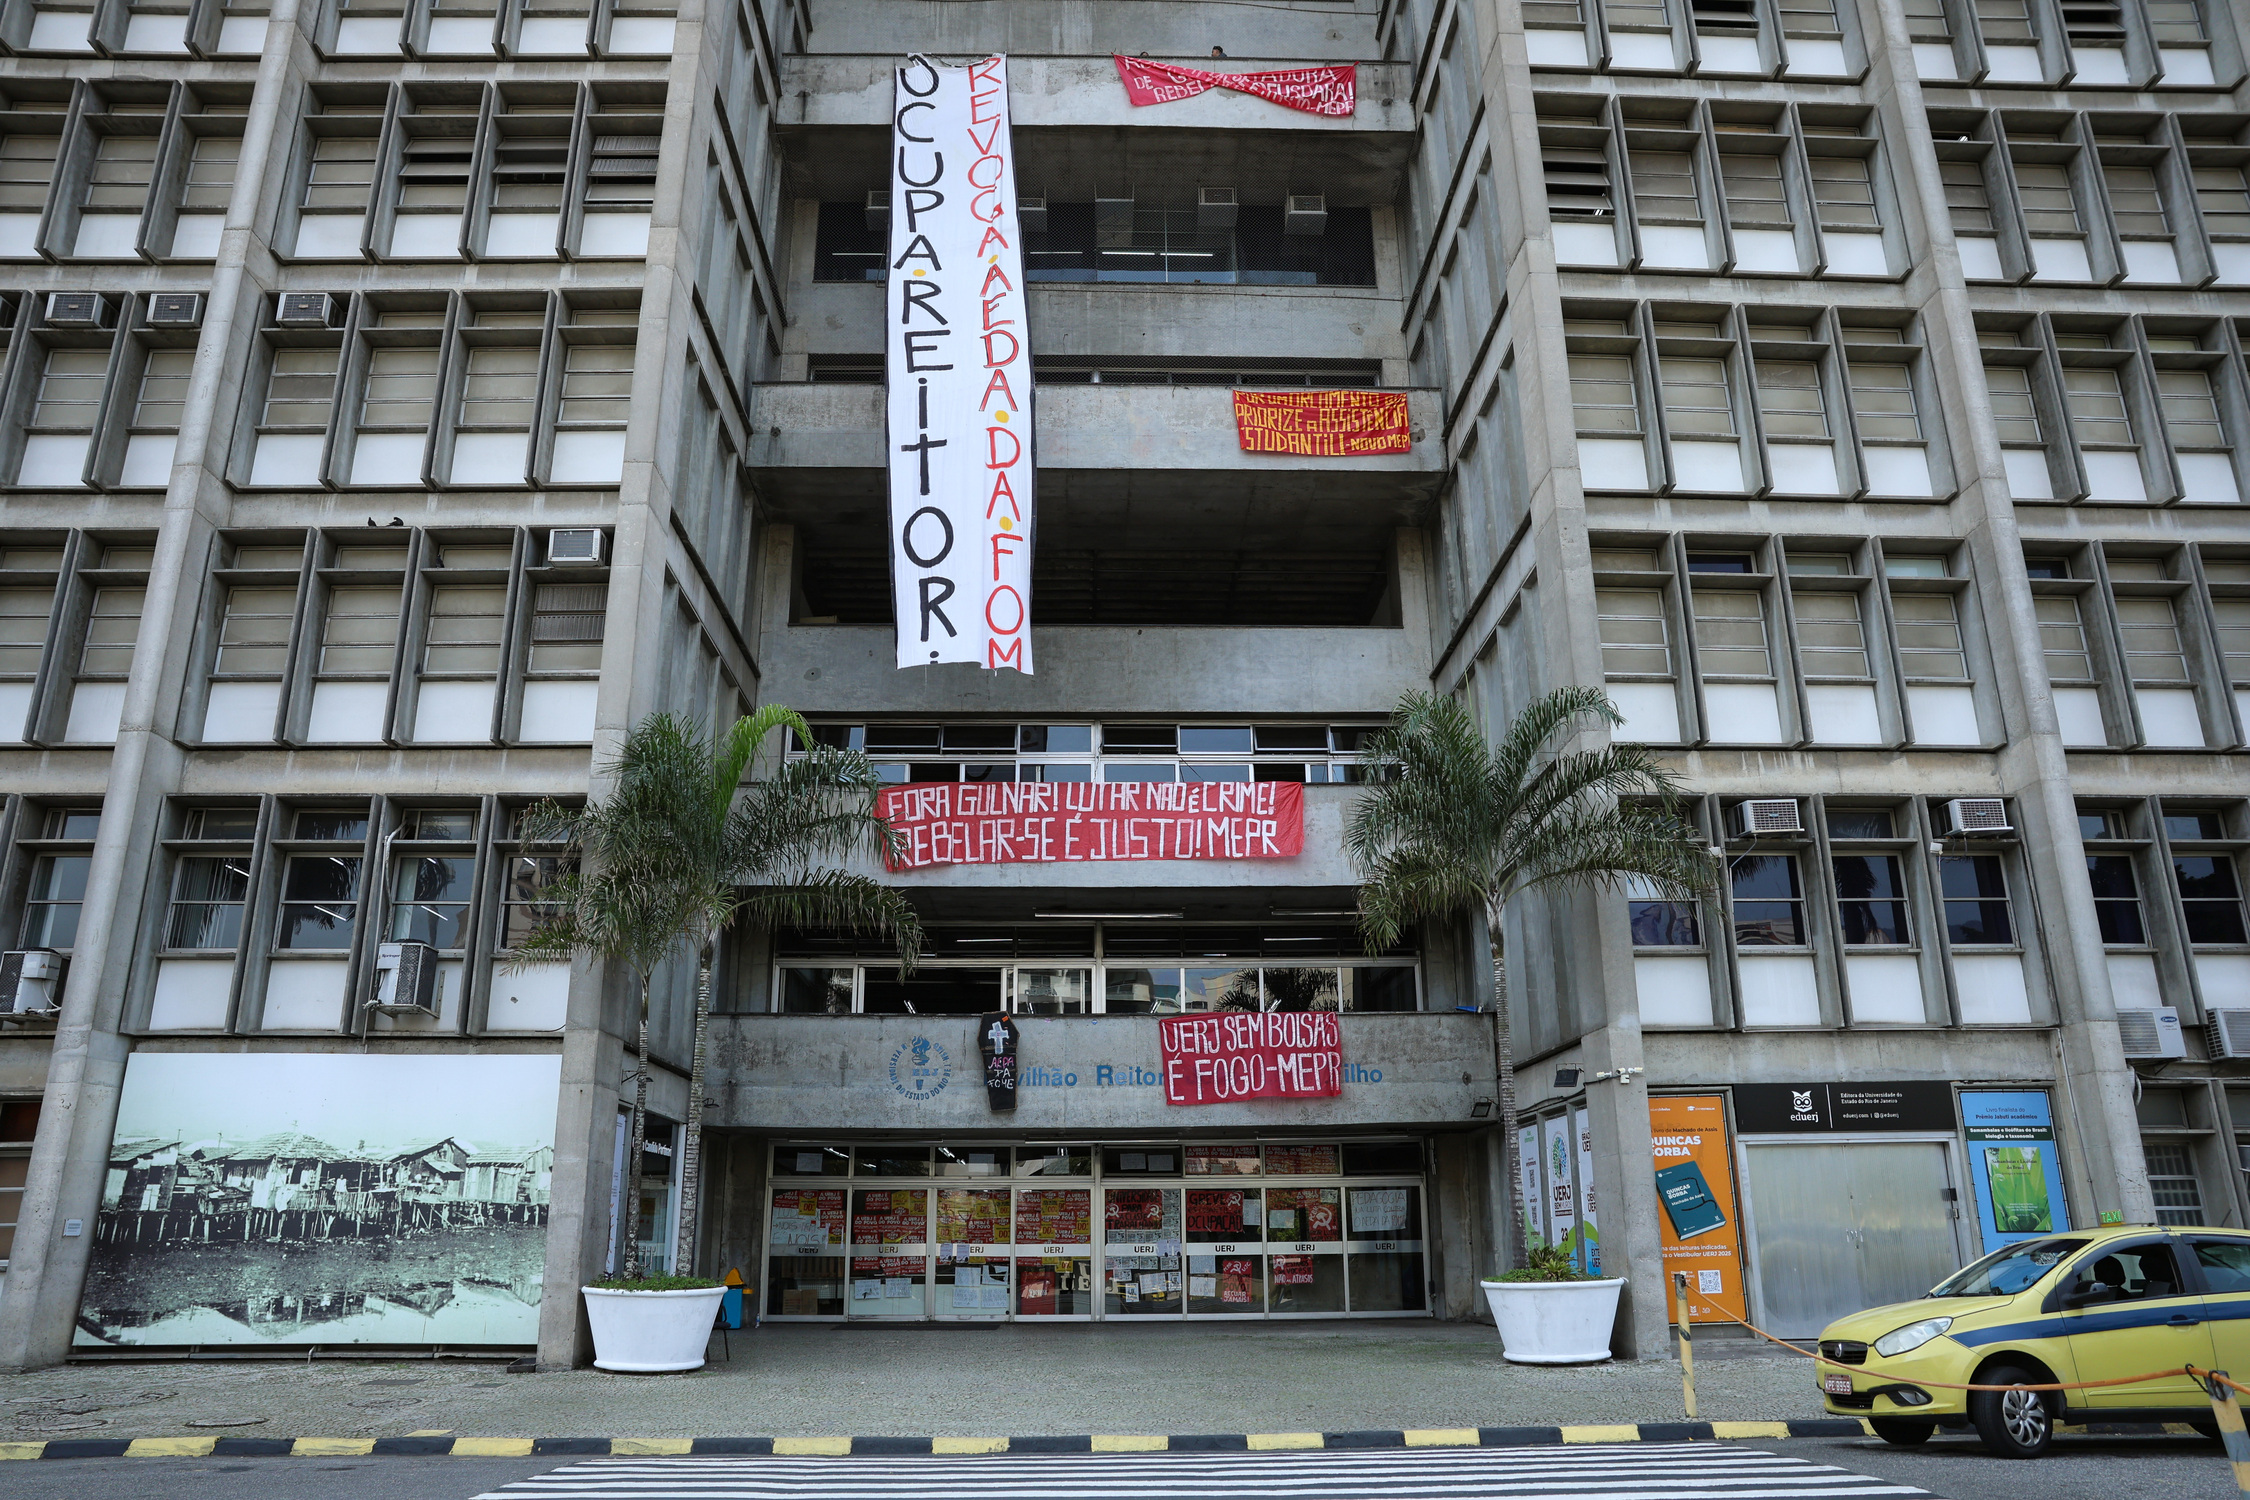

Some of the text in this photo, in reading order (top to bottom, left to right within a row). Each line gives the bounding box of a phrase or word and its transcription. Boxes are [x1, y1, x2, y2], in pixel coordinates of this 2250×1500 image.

[1134, 75, 1154, 90] DE
[893, 54, 944, 271] OCUPA
[967, 57, 1009, 258] REVOGA
[978, 263, 1019, 412] AEDA
[1235, 403, 1304, 431] PRIORIZE
[985, 427, 1021, 522] DA
[888, 785, 951, 822] FORA
[957, 781, 1059, 816] GULNAR!
[1065, 781, 1140, 812] LUTAR
[1188, 787, 1200, 814] É
[1202, 781, 1277, 815] CRIME!
[893, 813, 1281, 867] REBELAR-SE É JUSTO! MEPR
[1161, 1011, 1339, 1054] UERJ SEM BOLSAS
[1097, 1065, 1165, 1086] Reitor
[1344, 1064, 1382, 1083] ilho
[1167, 1052, 1185, 1101] É
[904, 1090, 930, 1101] ESTADO
[1790, 1112, 1819, 1122] eduerj
[1352, 1191, 1406, 1205] PEDAGOGIA
[1553, 1184, 1571, 1202] UERJ
[1666, 1184, 1691, 1195] QUINCAS
[1668, 1190, 1688, 1199] BORBA
[1189, 1193, 1226, 1205] GREVE
[2100, 1211, 2121, 1223] TAXI
[798, 1246, 819, 1254] UERJ
[1044, 1246, 1064, 1254] UERJ
